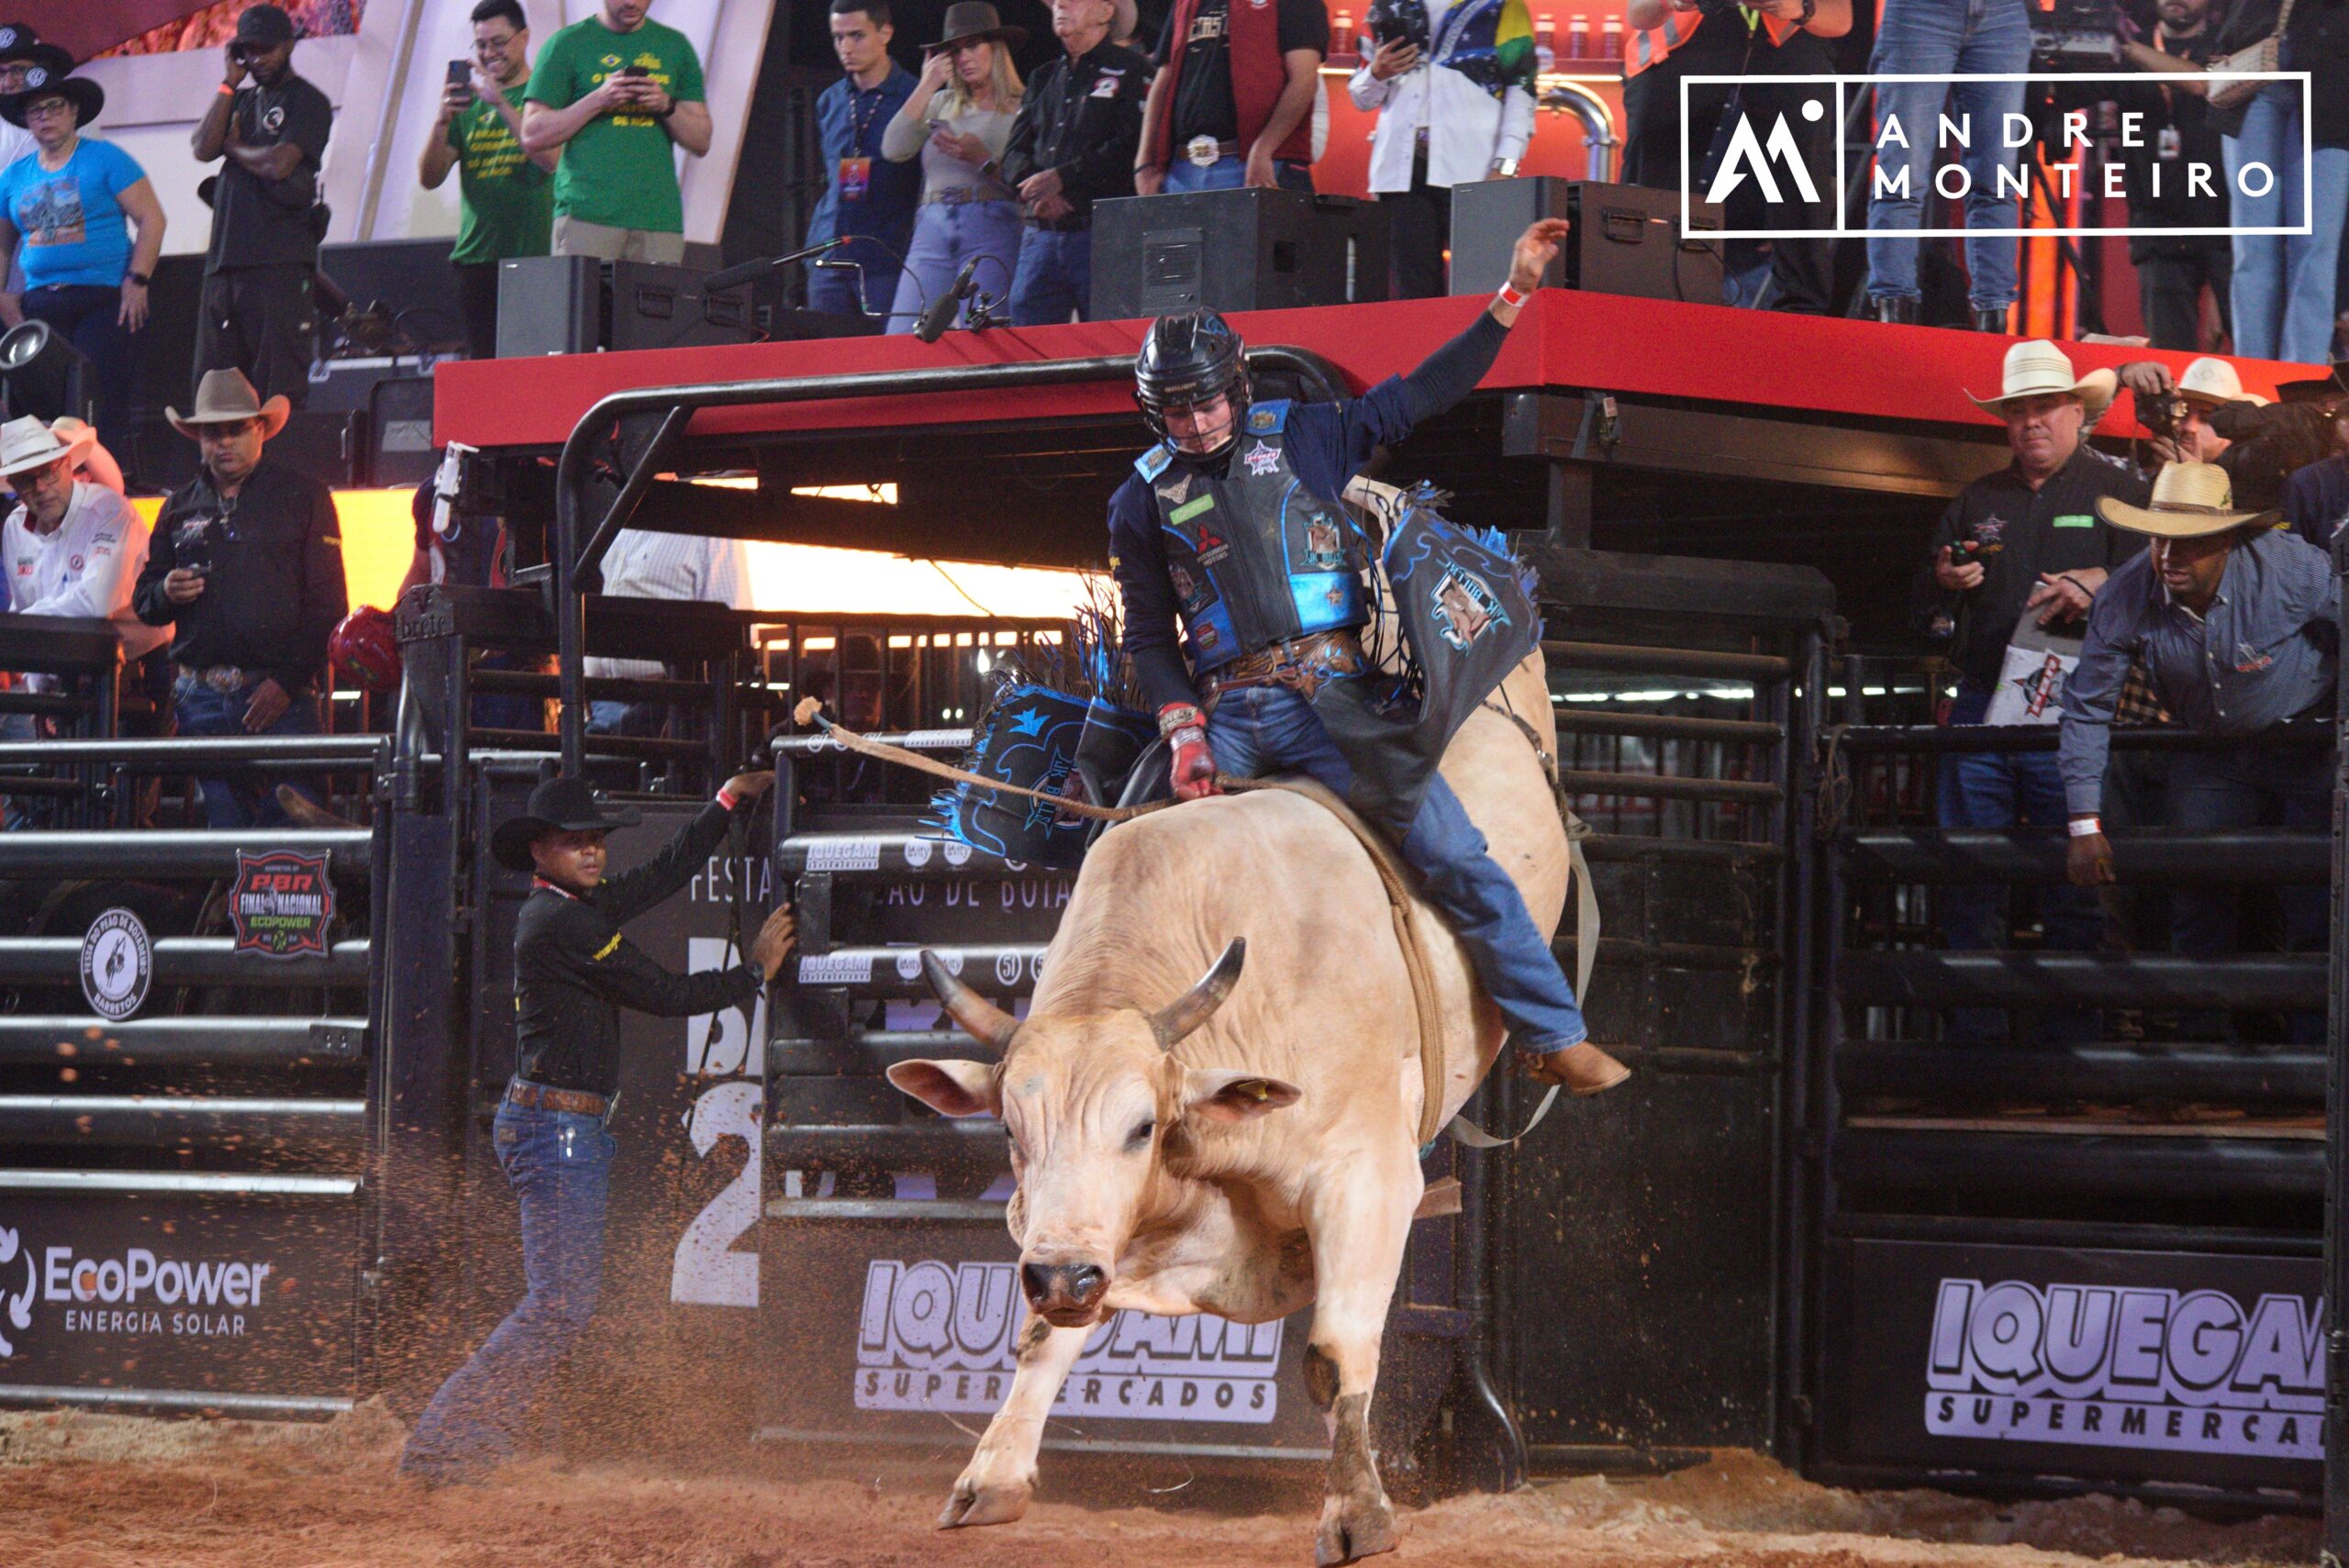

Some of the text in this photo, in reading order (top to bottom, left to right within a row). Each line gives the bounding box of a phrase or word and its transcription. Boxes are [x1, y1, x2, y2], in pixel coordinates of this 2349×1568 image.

[250, 874, 313, 891] PBR
[240, 894, 321, 916] FINAL NACIONAL
[250, 917, 311, 929] ECOPOWER
[84, 941, 93, 974] FESTA
[119, 916, 128, 929] DE
[128, 921, 147, 976] BOIADEIRO
[1003, 956, 1016, 978] 51
[94, 993, 138, 1014] BARRETOS
[44, 1246, 270, 1307] EcoPower
[65, 1310, 246, 1337] ENERGIA SOLAR
[1929, 1279, 2326, 1392] IQUEGA
[864, 1372, 1268, 1410] SUPERERCADOS
